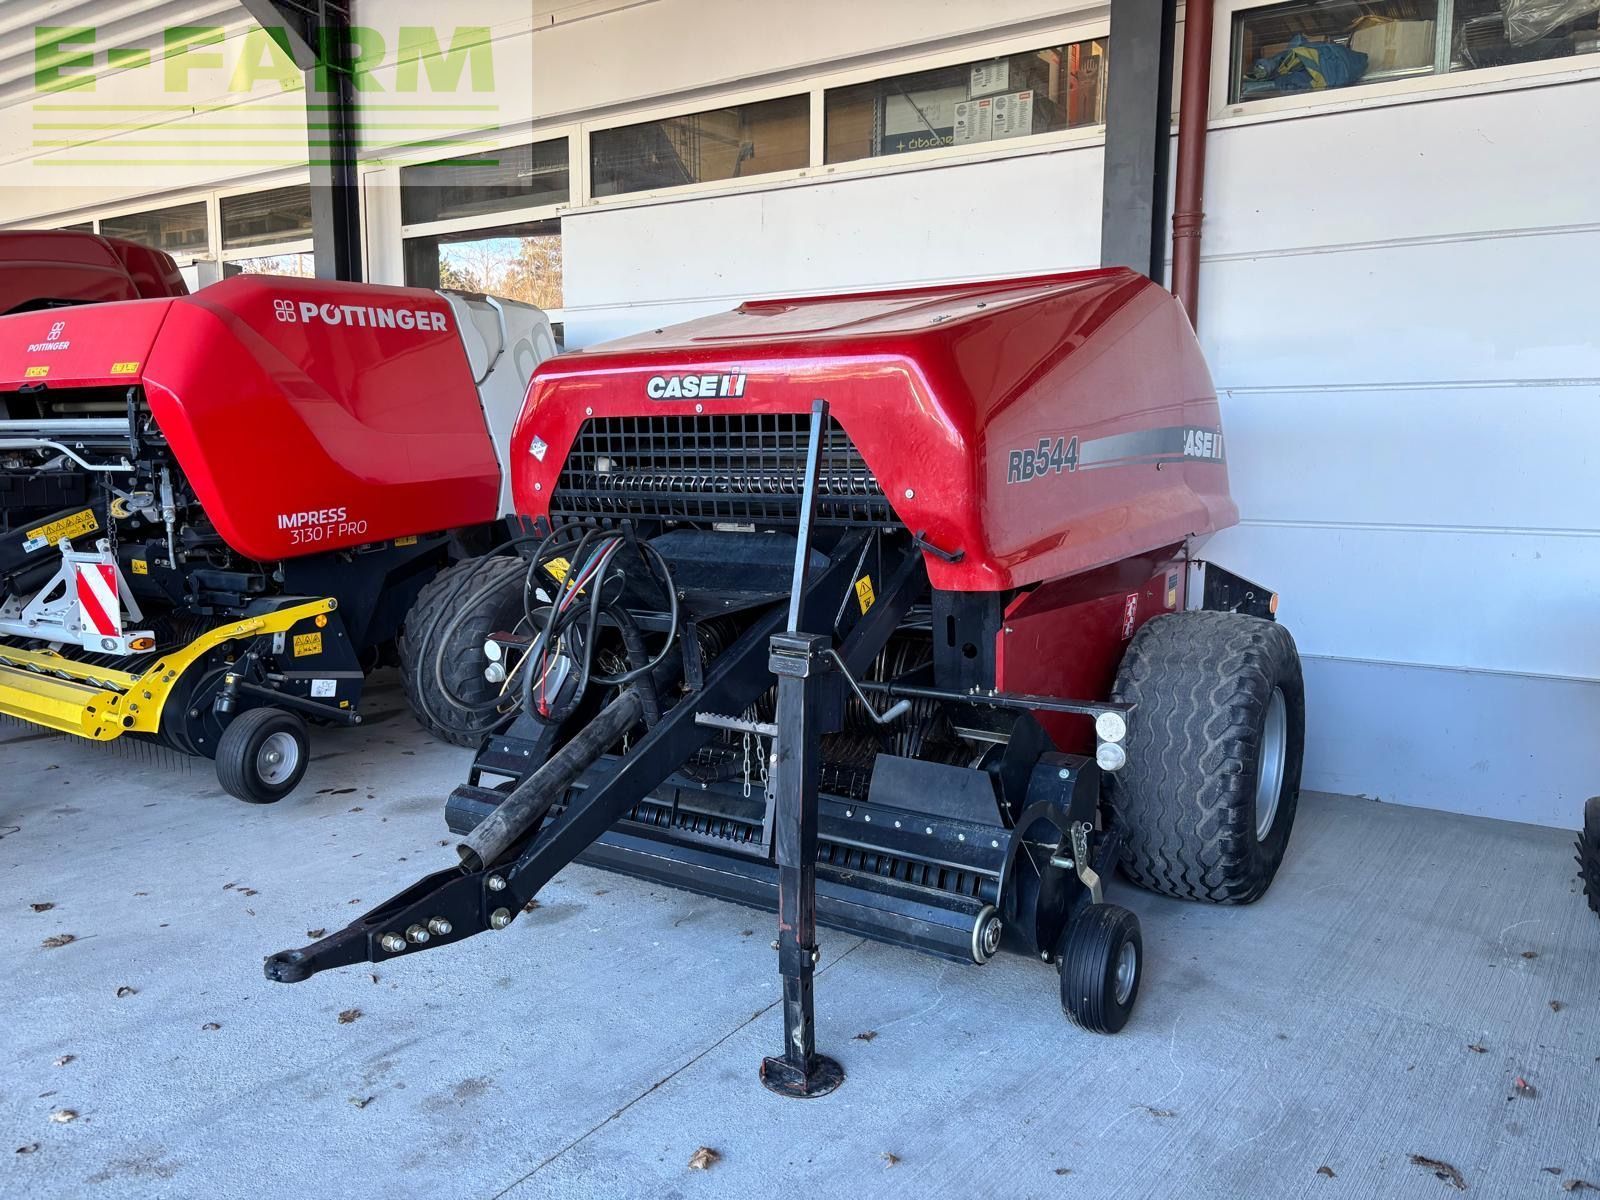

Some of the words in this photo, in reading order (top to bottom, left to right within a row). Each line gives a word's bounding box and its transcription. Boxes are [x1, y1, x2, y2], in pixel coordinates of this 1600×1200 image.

[647, 375, 718, 398] CASE
[1184, 430, 1213, 458] ASE
[1007, 435, 1079, 485] RB544
[278, 507, 347, 529] IMPRESS
[290, 526, 323, 545] 3130
[327, 524, 335, 539] F
[338, 520, 368, 537] PRO
